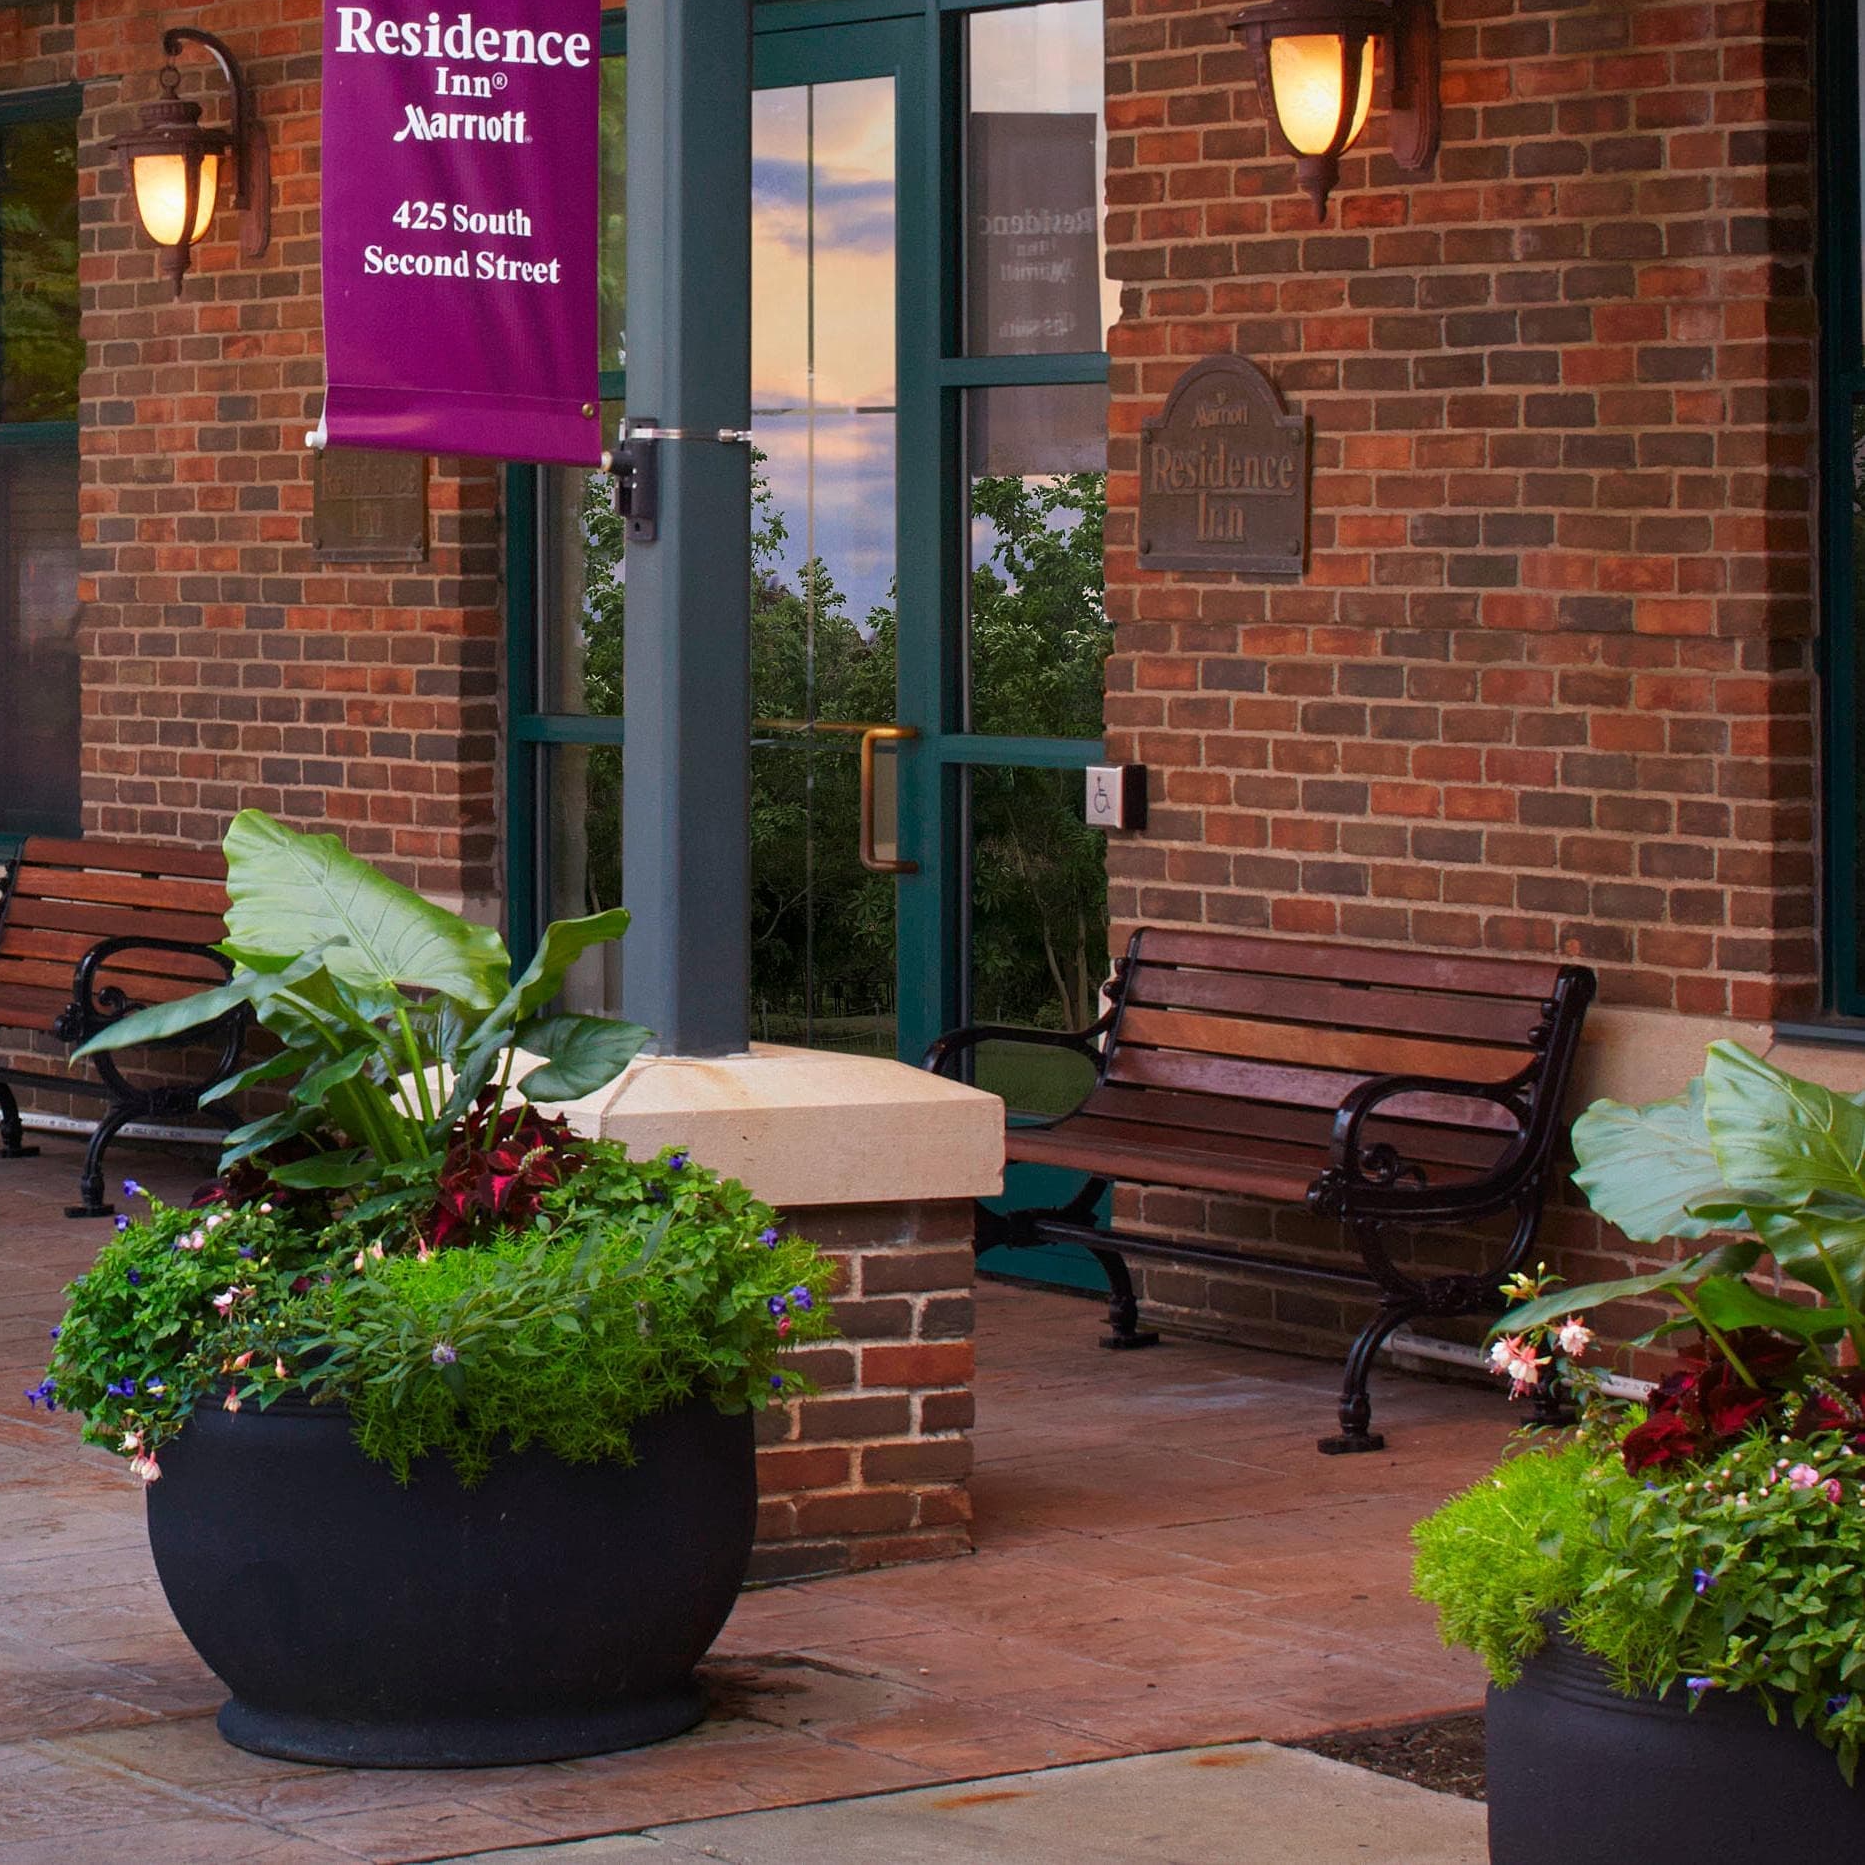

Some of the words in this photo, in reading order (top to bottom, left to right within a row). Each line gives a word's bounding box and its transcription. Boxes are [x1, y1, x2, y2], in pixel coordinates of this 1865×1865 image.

[335, 6, 591, 67] Residence
[393, 103, 527, 144] Marriott
[392, 201, 447, 231] 425
[453, 203, 532, 237] South
[363, 245, 470, 280] Second
[476, 250, 561, 285] Street
[1150, 437, 1295, 495] Residence
[1196, 492, 1246, 543] Inn
